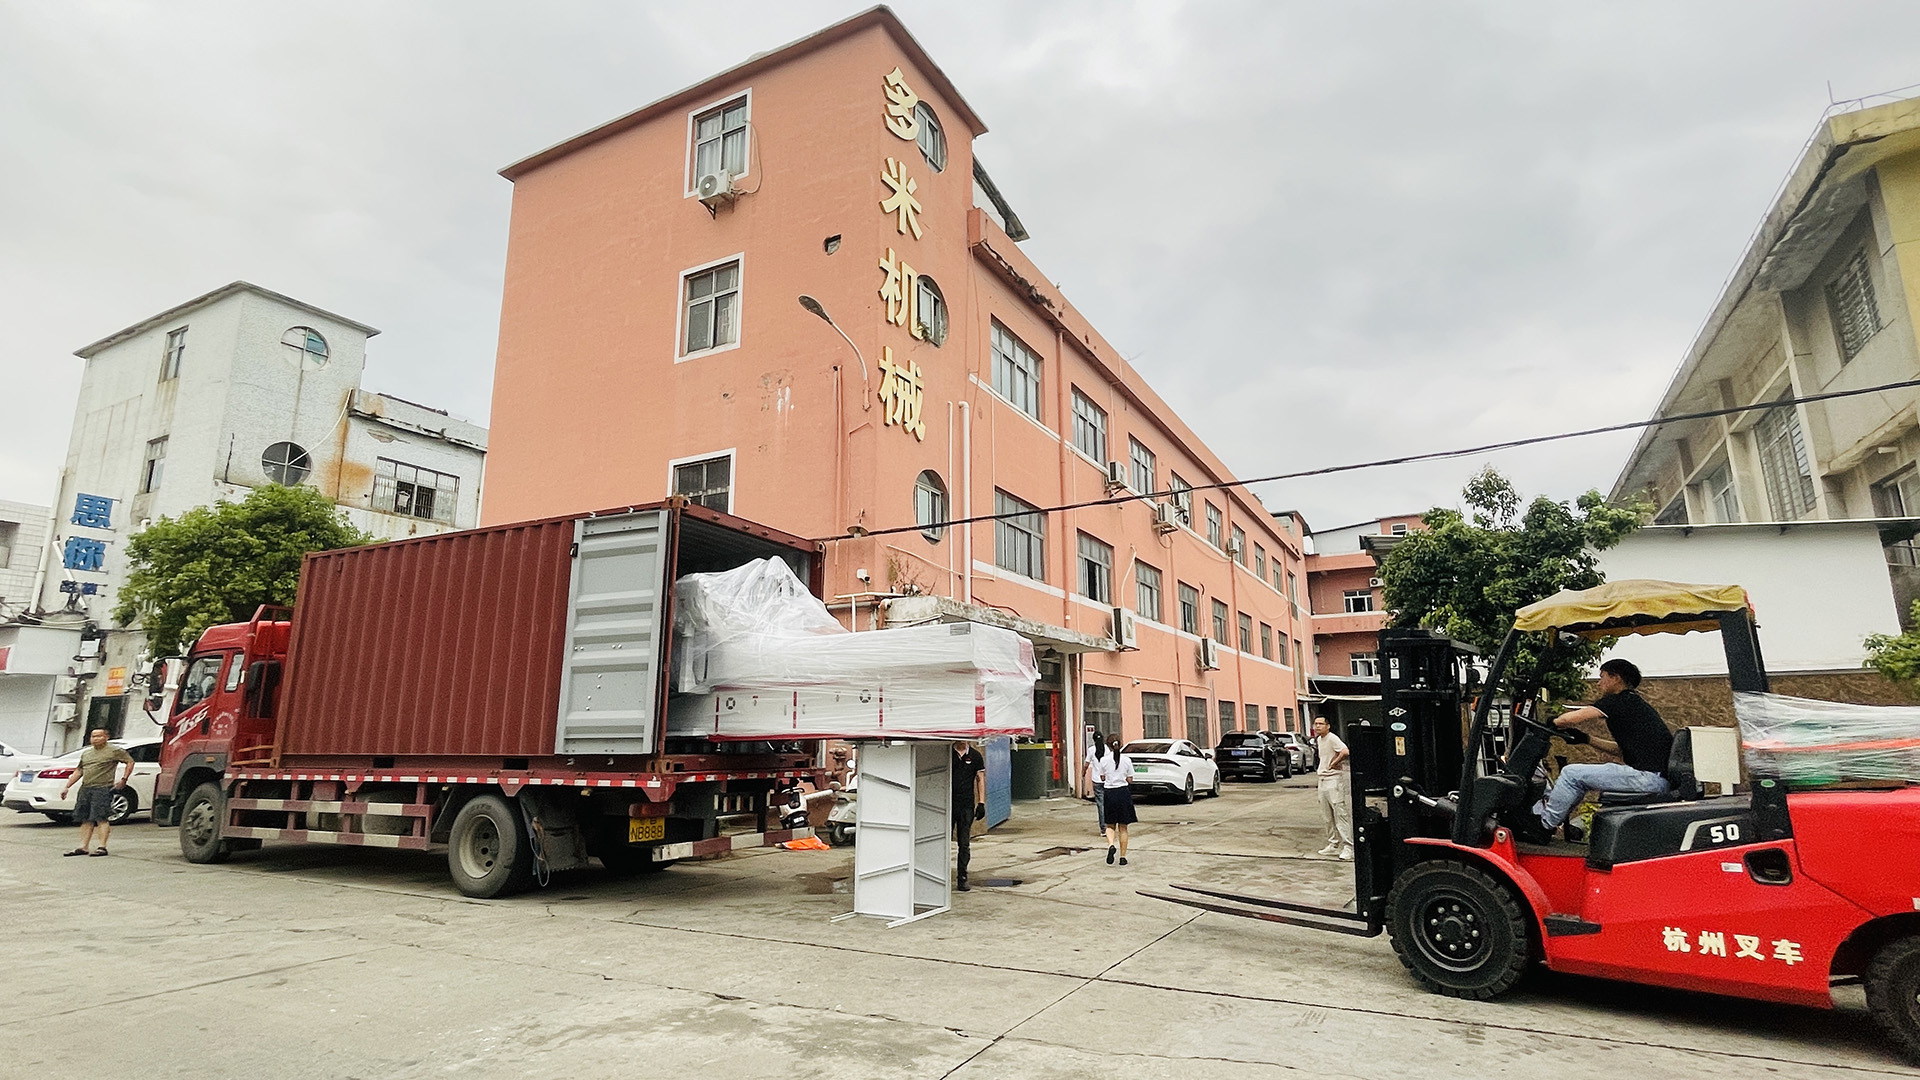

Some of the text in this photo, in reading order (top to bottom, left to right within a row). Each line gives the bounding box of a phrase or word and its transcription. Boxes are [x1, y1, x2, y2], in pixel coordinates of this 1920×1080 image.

[879, 67, 926, 441] 多米机械
[1710, 824, 1740, 843] 50
[1662, 926, 1804, 965] 杭州叉车
